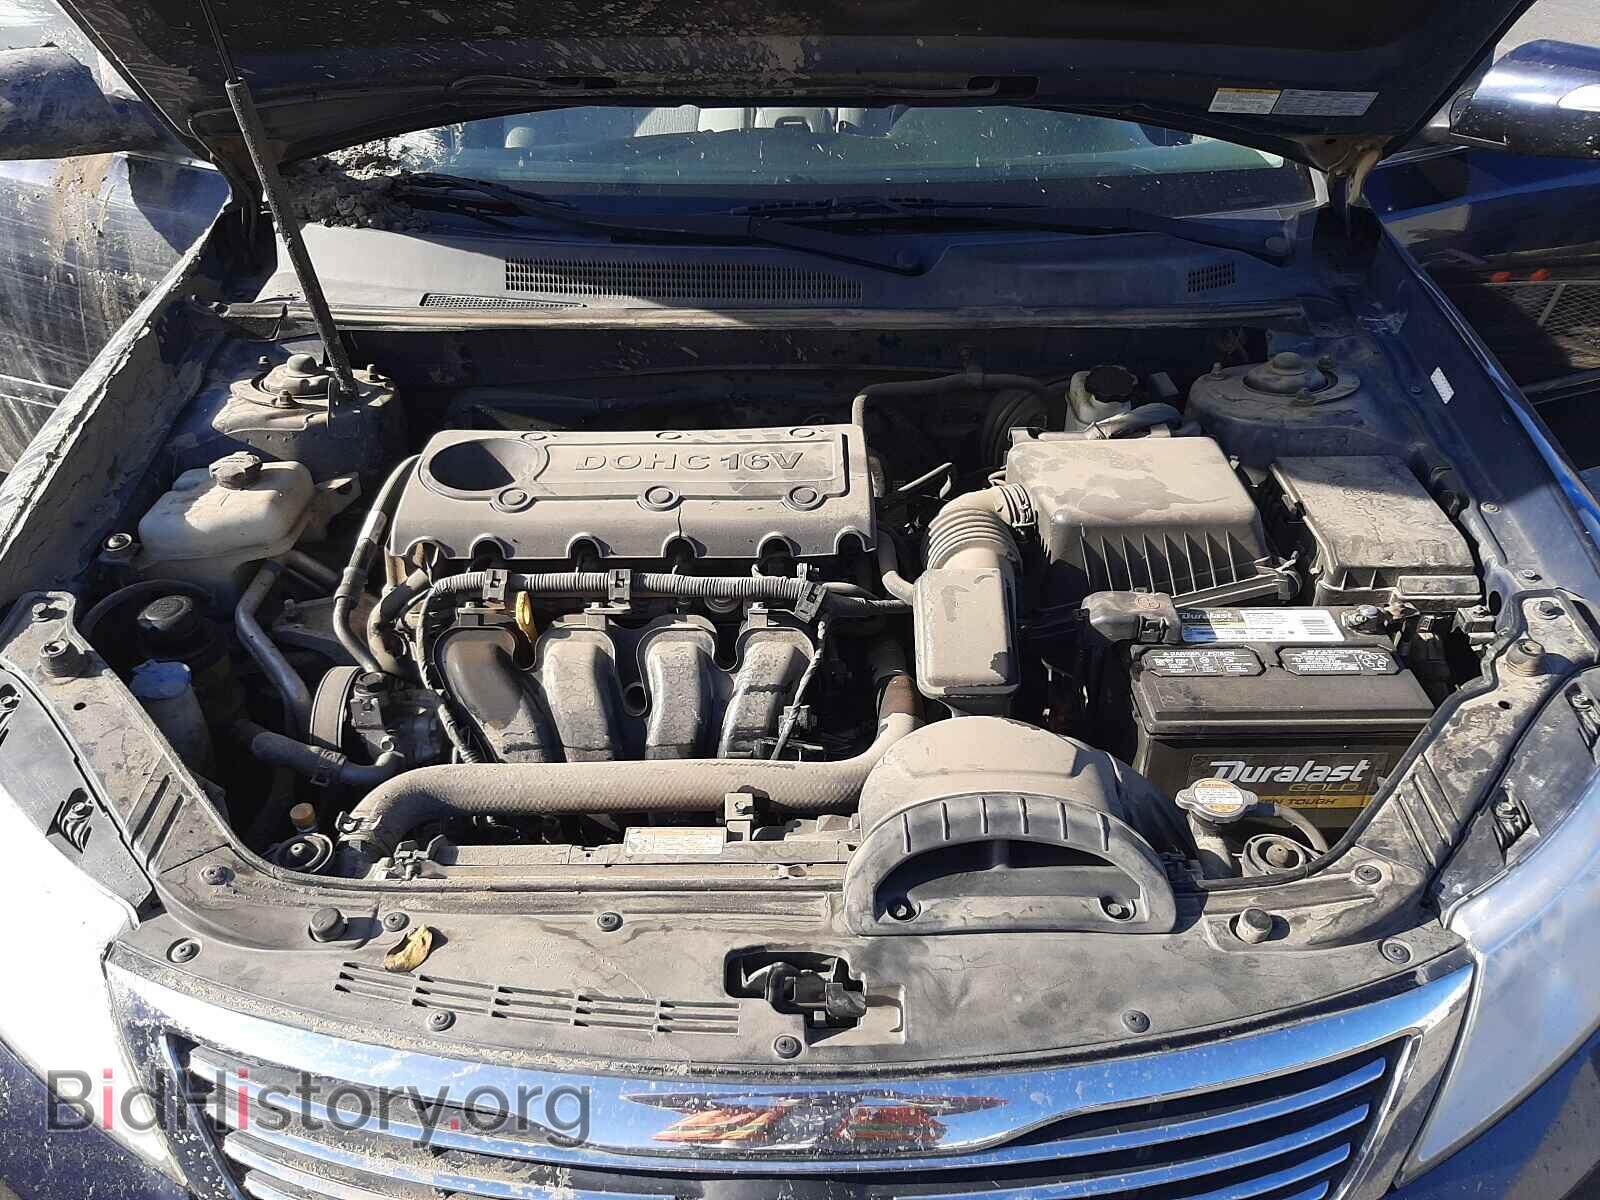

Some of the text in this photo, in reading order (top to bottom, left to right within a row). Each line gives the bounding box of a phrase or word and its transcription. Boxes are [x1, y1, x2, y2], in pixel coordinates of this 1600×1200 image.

[576, 451, 804, 471] DOHC 16V
[1210, 760, 1371, 783] Duralast
[1289, 784, 1359, 792] GOLD
[1288, 798, 1338, 806] TOUGH
